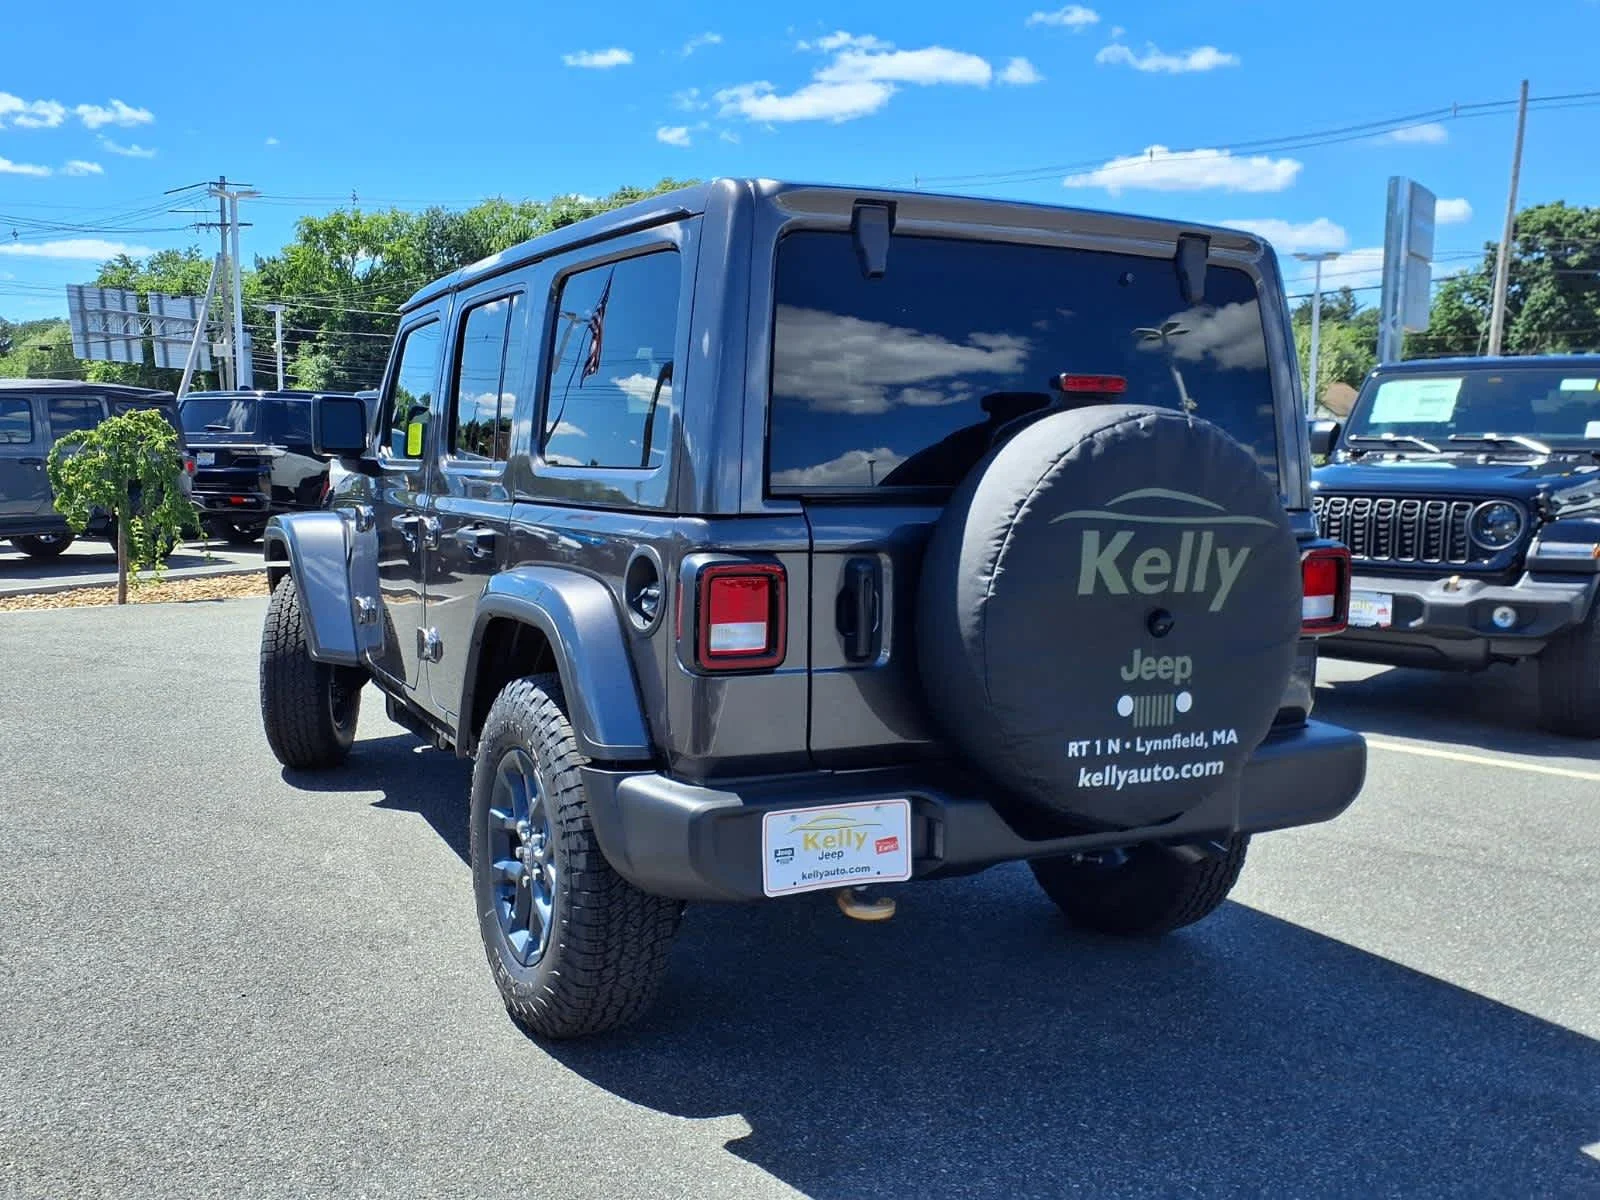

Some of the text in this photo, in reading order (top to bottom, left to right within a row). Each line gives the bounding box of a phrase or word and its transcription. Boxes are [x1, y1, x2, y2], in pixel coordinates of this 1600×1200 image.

[1078, 530, 1251, 612] Kelly
[1120, 649, 1193, 685] Jeep
[1068, 729, 1239, 757] RT 1 N Lynnfield, MA
[1078, 759, 1225, 790] kellyauto.com
[803, 828, 869, 851] Kelly
[818, 849, 844, 861] Jeep
[801, 864, 871, 881] kellyauto.com
